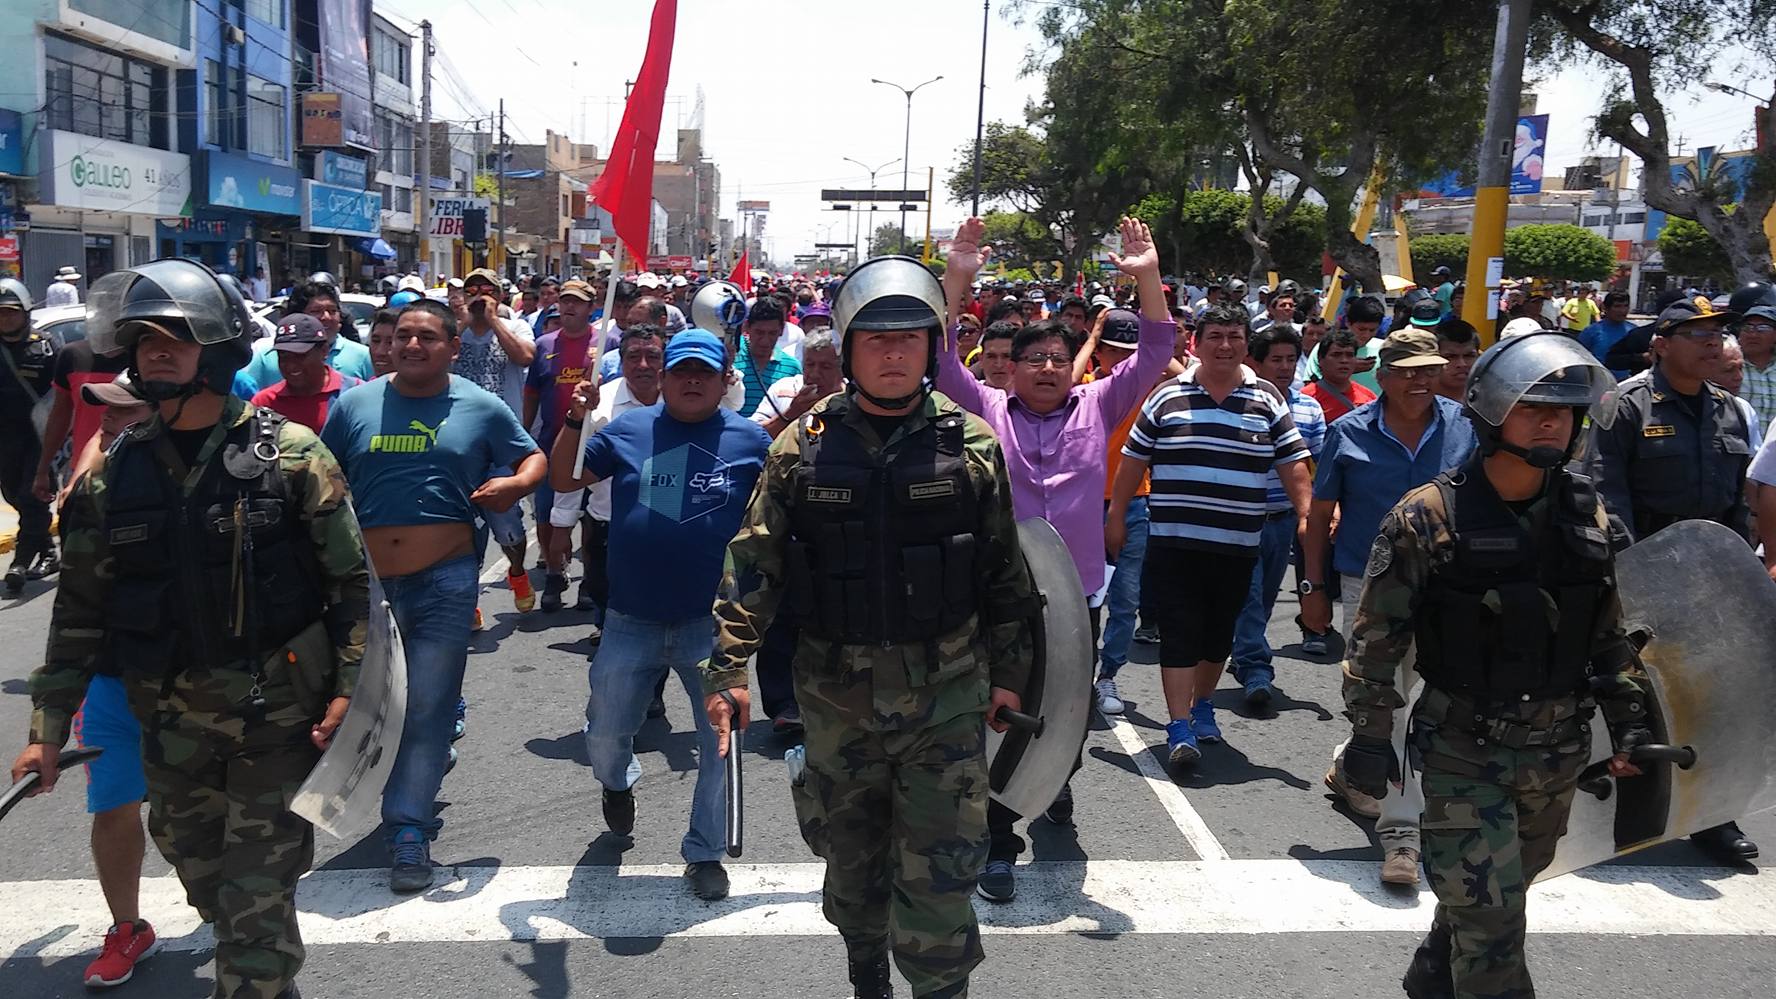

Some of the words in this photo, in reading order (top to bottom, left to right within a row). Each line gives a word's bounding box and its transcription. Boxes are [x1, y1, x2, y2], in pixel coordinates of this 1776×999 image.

[144, 168, 156, 184] 41
[369, 435, 427, 453] PUMA
[648, 474, 679, 487] FOX
